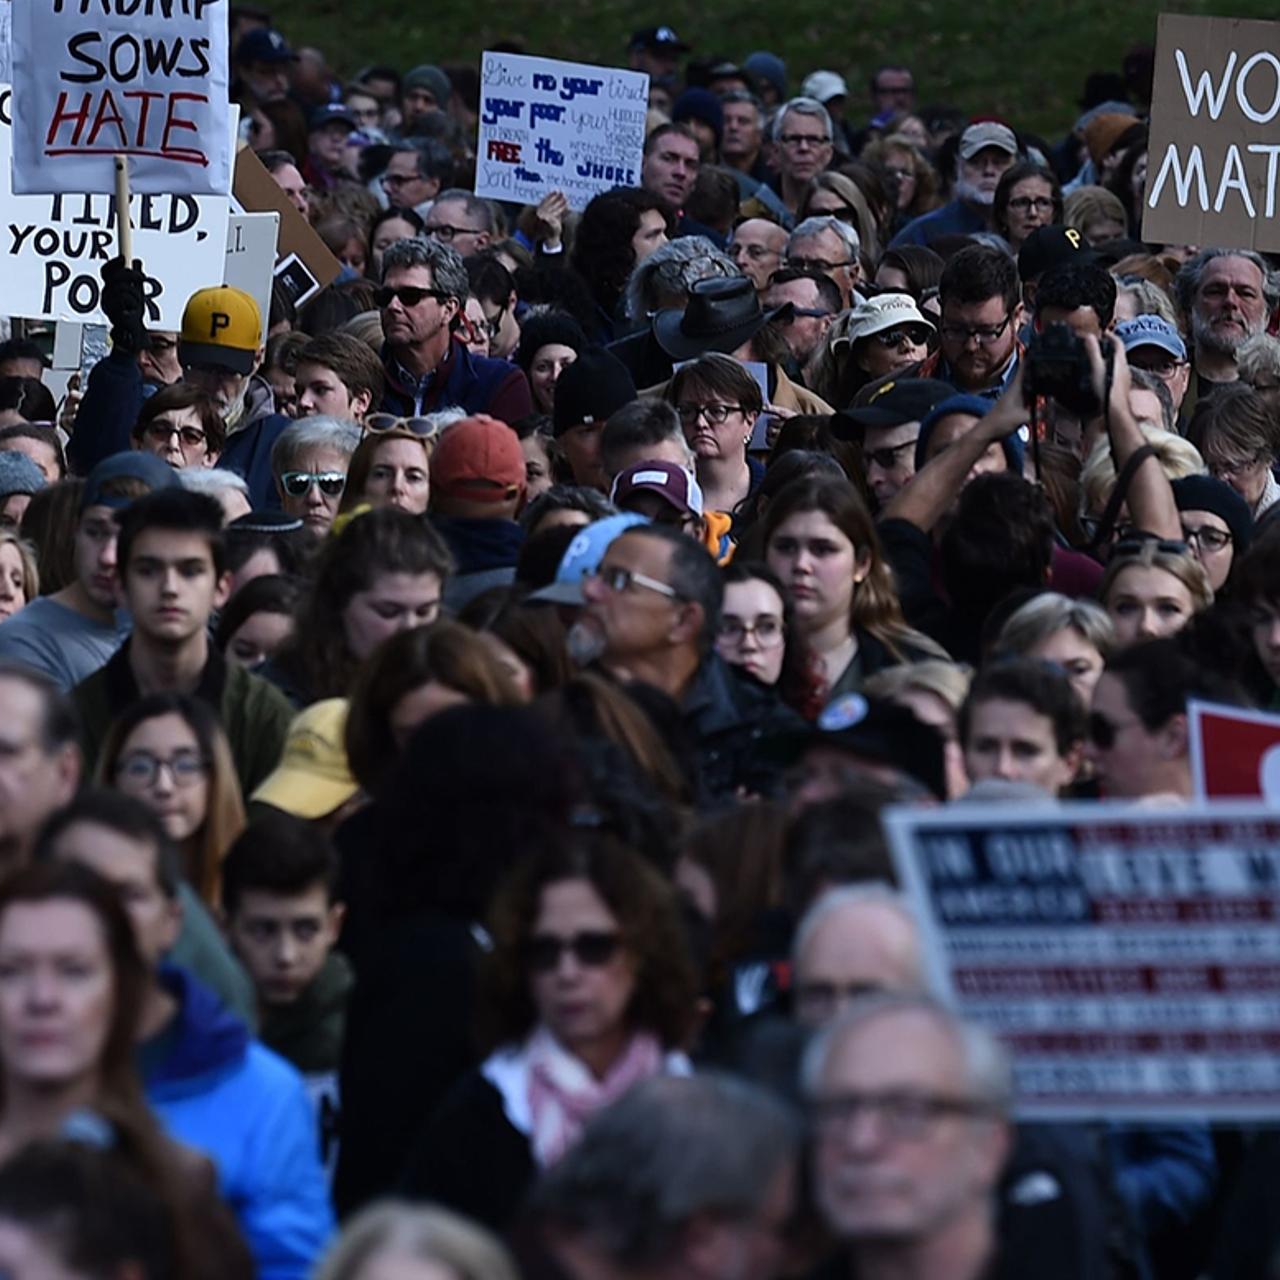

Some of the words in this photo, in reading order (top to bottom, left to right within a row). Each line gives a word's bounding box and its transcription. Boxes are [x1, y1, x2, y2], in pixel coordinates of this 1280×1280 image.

[60, 31, 210, 84] SOWS
[559, 75, 604, 100] your
[45, 89, 210, 160] HATE
[482, 97, 525, 125] your
[9, 223, 113, 260] YOUR
[1064, 228, 1081, 250] P
[43, 260, 164, 322] POR
[209, 313, 231, 338] P
